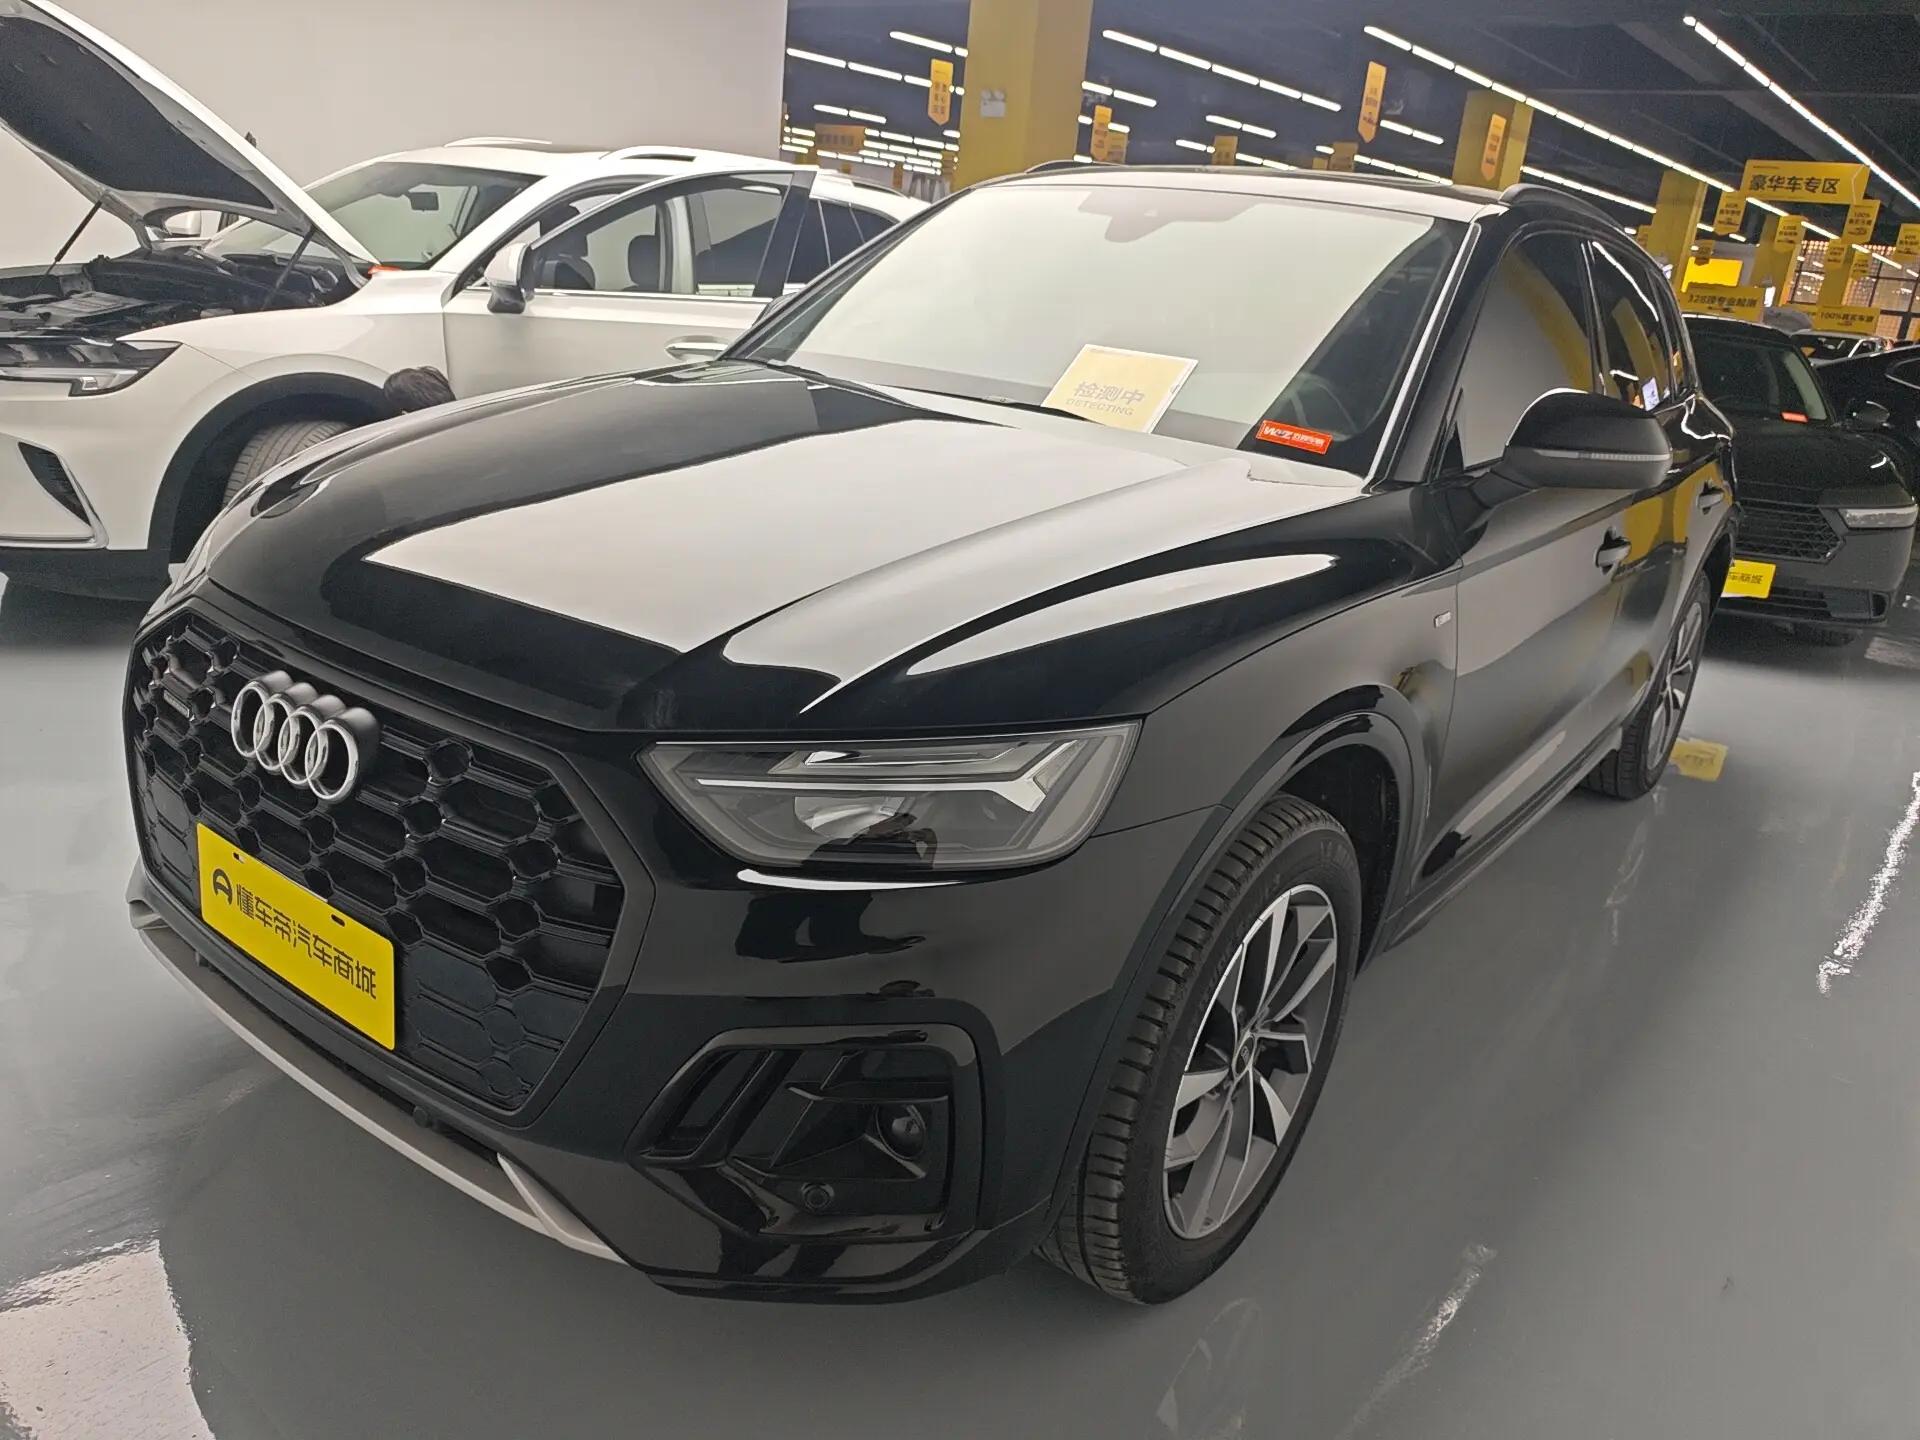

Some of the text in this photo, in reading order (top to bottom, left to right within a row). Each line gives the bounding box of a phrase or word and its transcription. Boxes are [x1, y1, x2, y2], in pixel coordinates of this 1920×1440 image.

[1749, 174, 1841, 195] 豪华车专区
[1073, 381, 1145, 405] 检测中
[1065, 398, 1135, 416] DETECTING
[236, 883, 377, 1000] 懂车帝汽车商城
